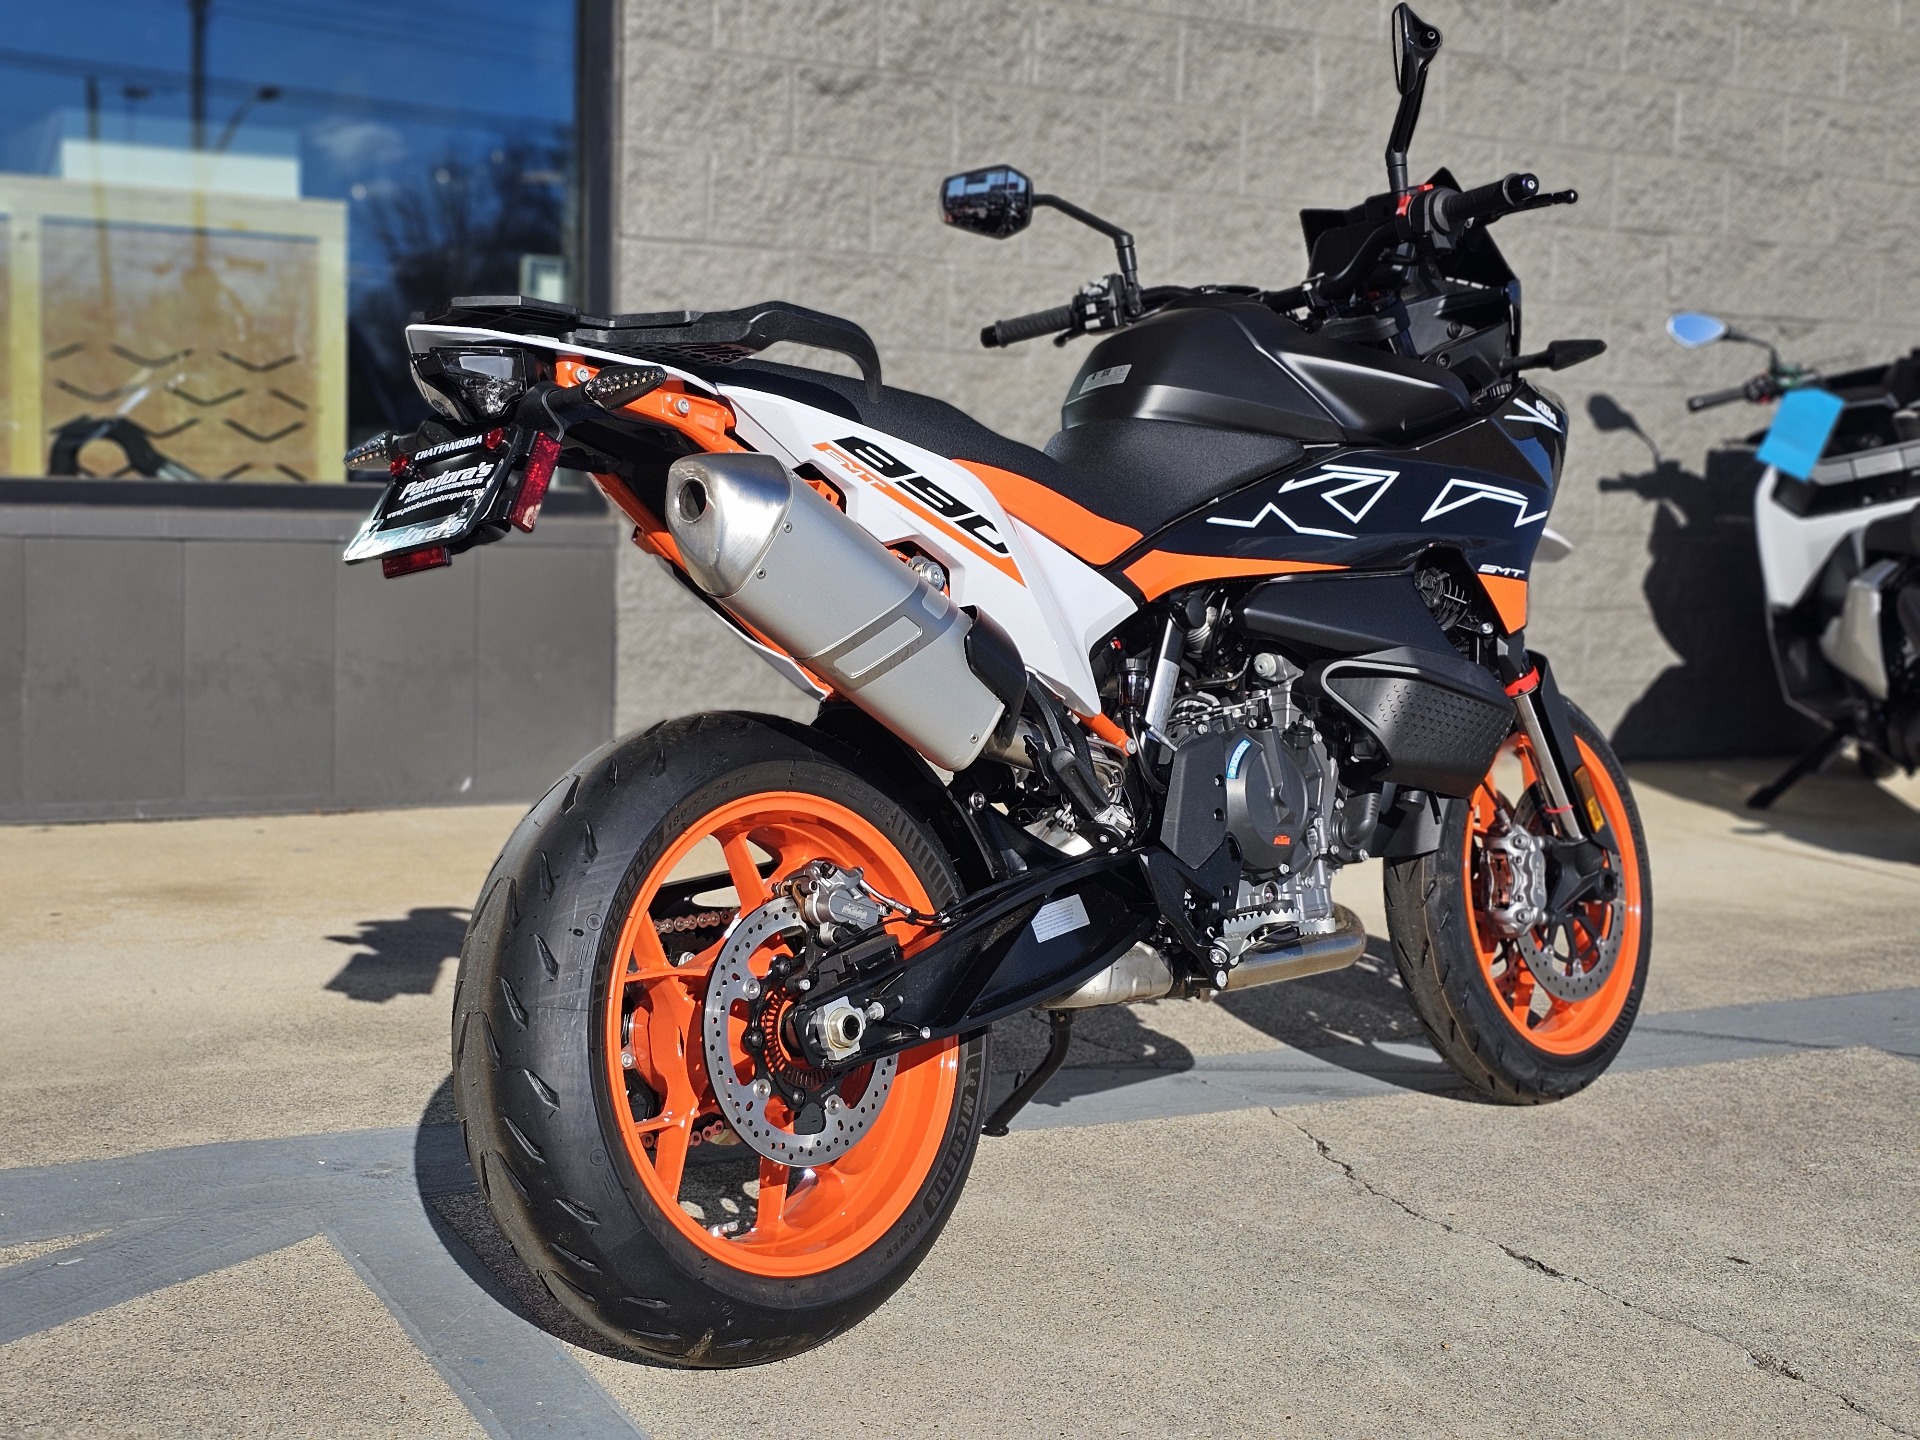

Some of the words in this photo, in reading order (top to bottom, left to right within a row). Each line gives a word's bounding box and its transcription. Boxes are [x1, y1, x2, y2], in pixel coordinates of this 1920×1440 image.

[1535, 399, 1557, 424] KTM
[414, 434, 483, 461] CHATTANOOGA
[398, 461, 495, 501] Pandora's
[832, 436, 1009, 554] 990
[1478, 563, 1526, 578] SMT
[1273, 834, 1291, 846] KTM
[926, 1092, 978, 1209] MICHELIN
[885, 1213, 924, 1260] POWER
